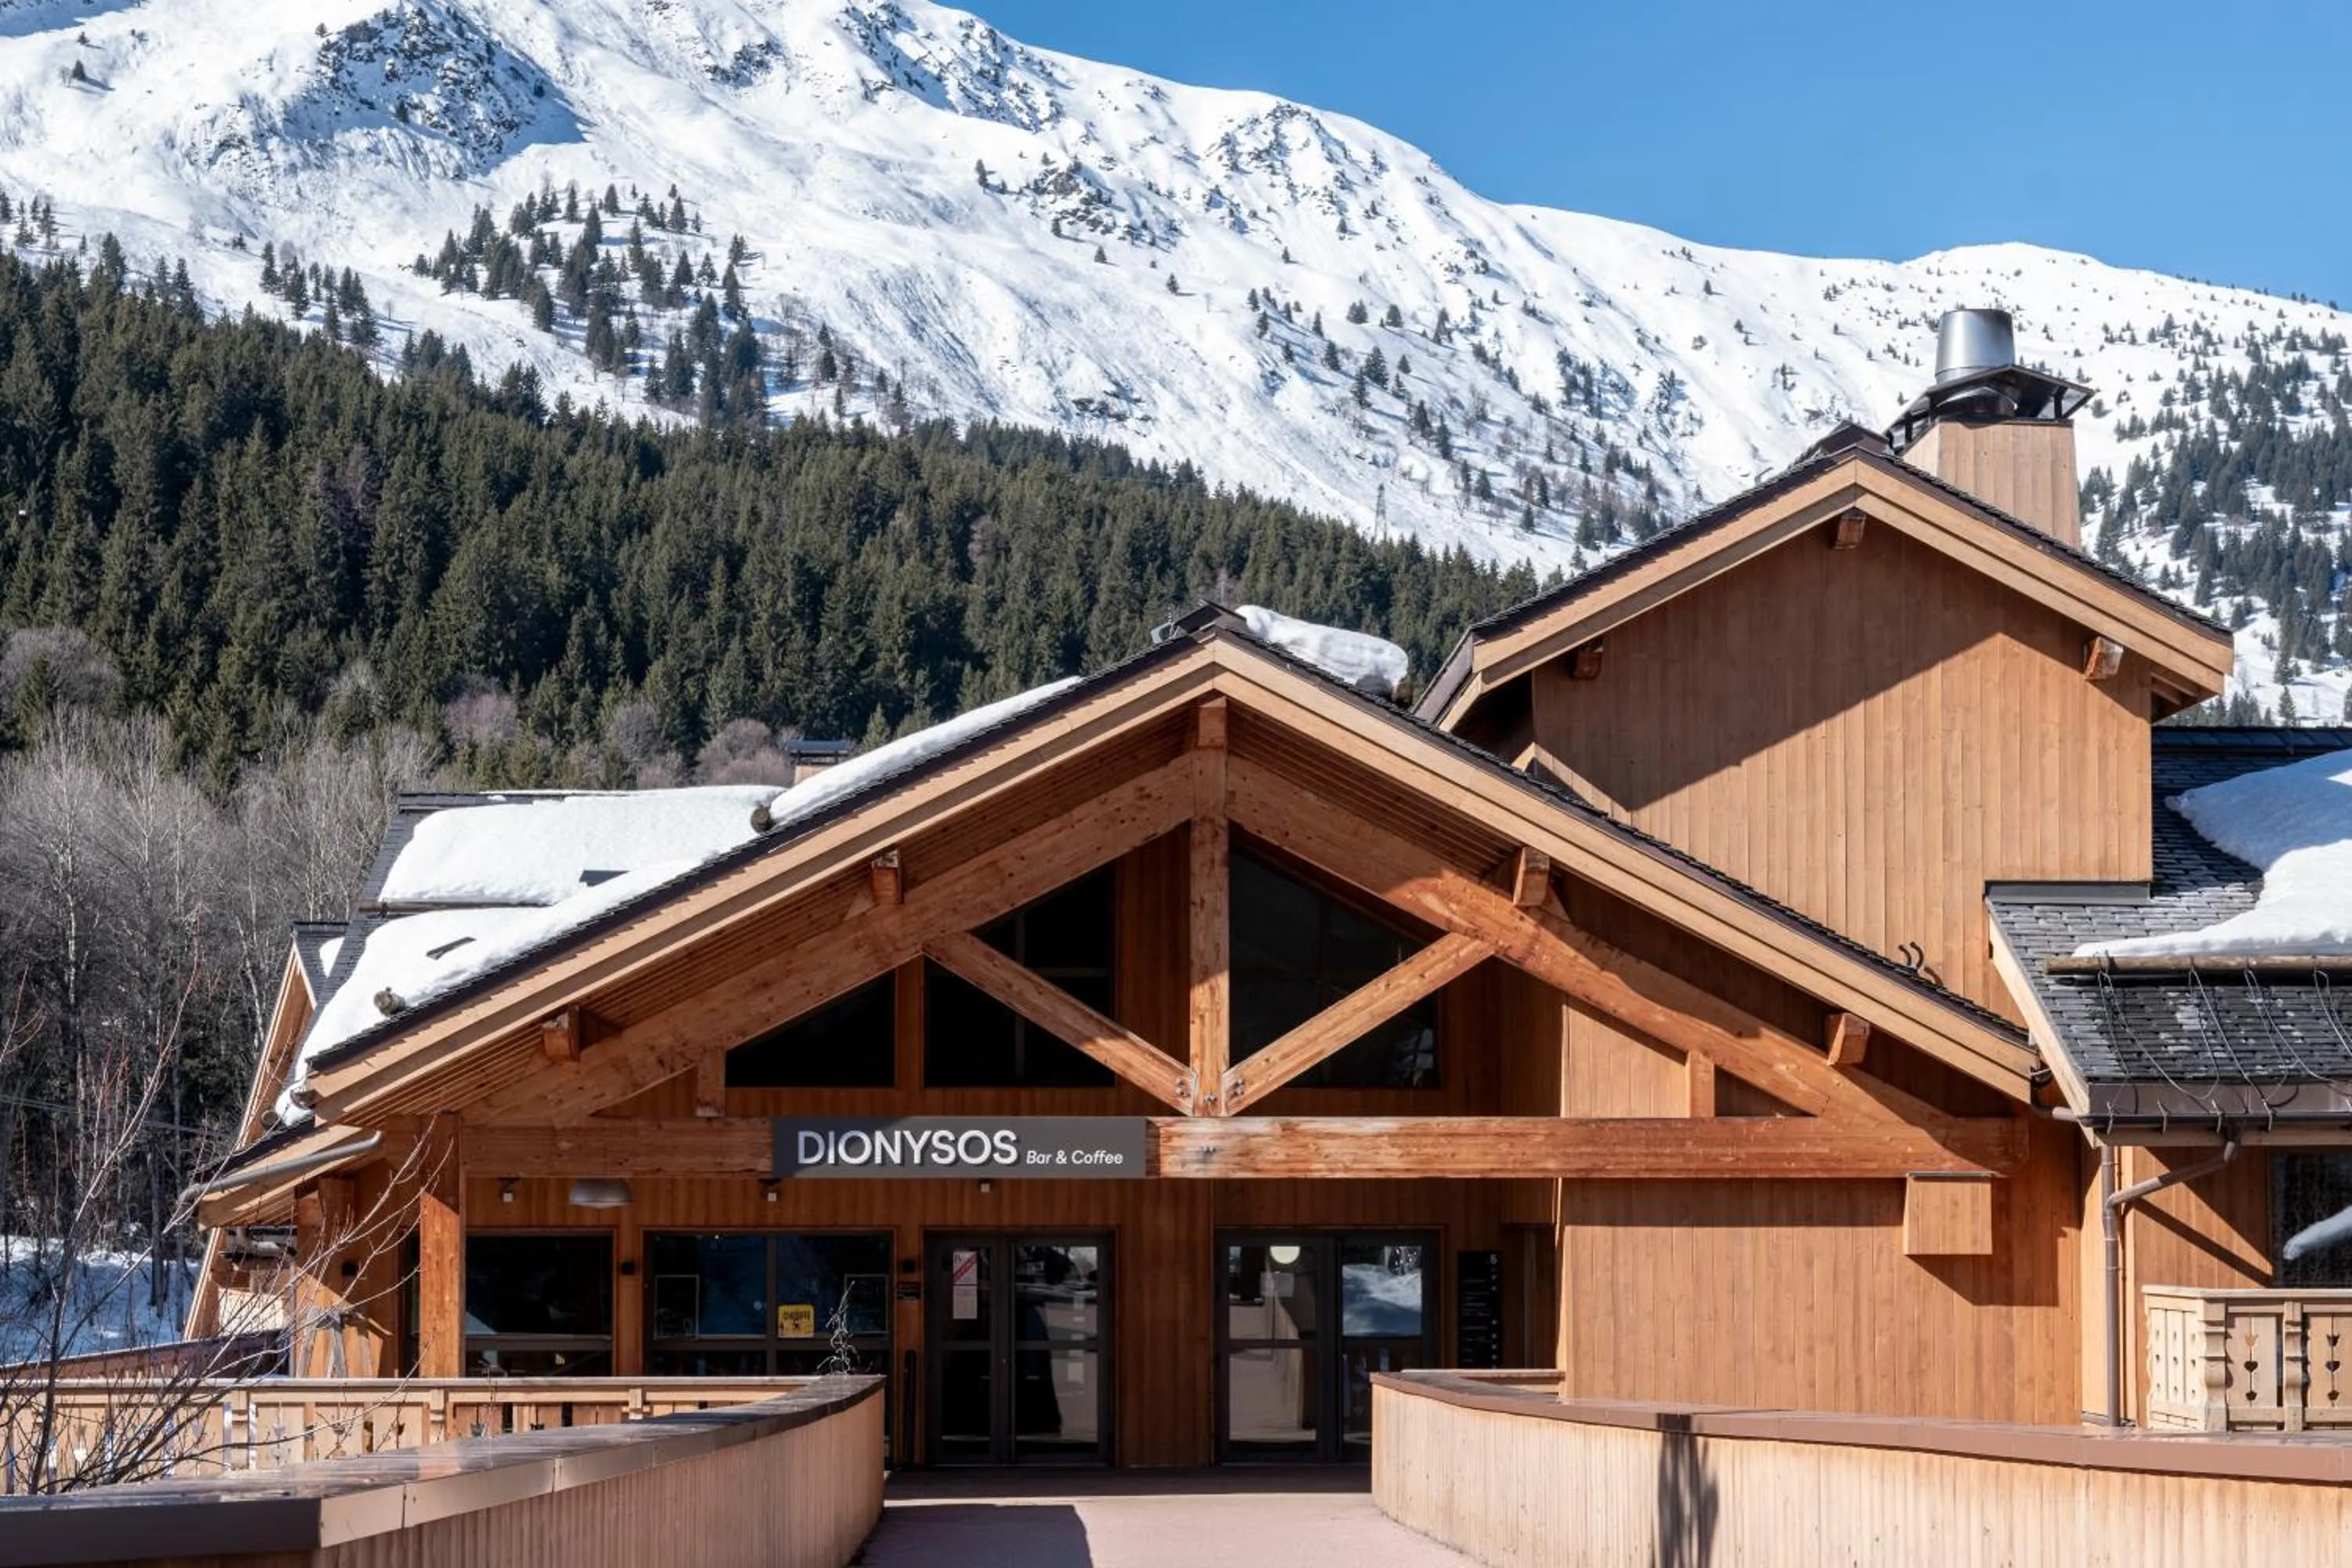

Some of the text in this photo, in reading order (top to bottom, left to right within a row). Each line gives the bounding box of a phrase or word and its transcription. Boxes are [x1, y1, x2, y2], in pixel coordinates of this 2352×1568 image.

[797, 1130, 1123, 1165] DIONYSOS Bar & Coffee
